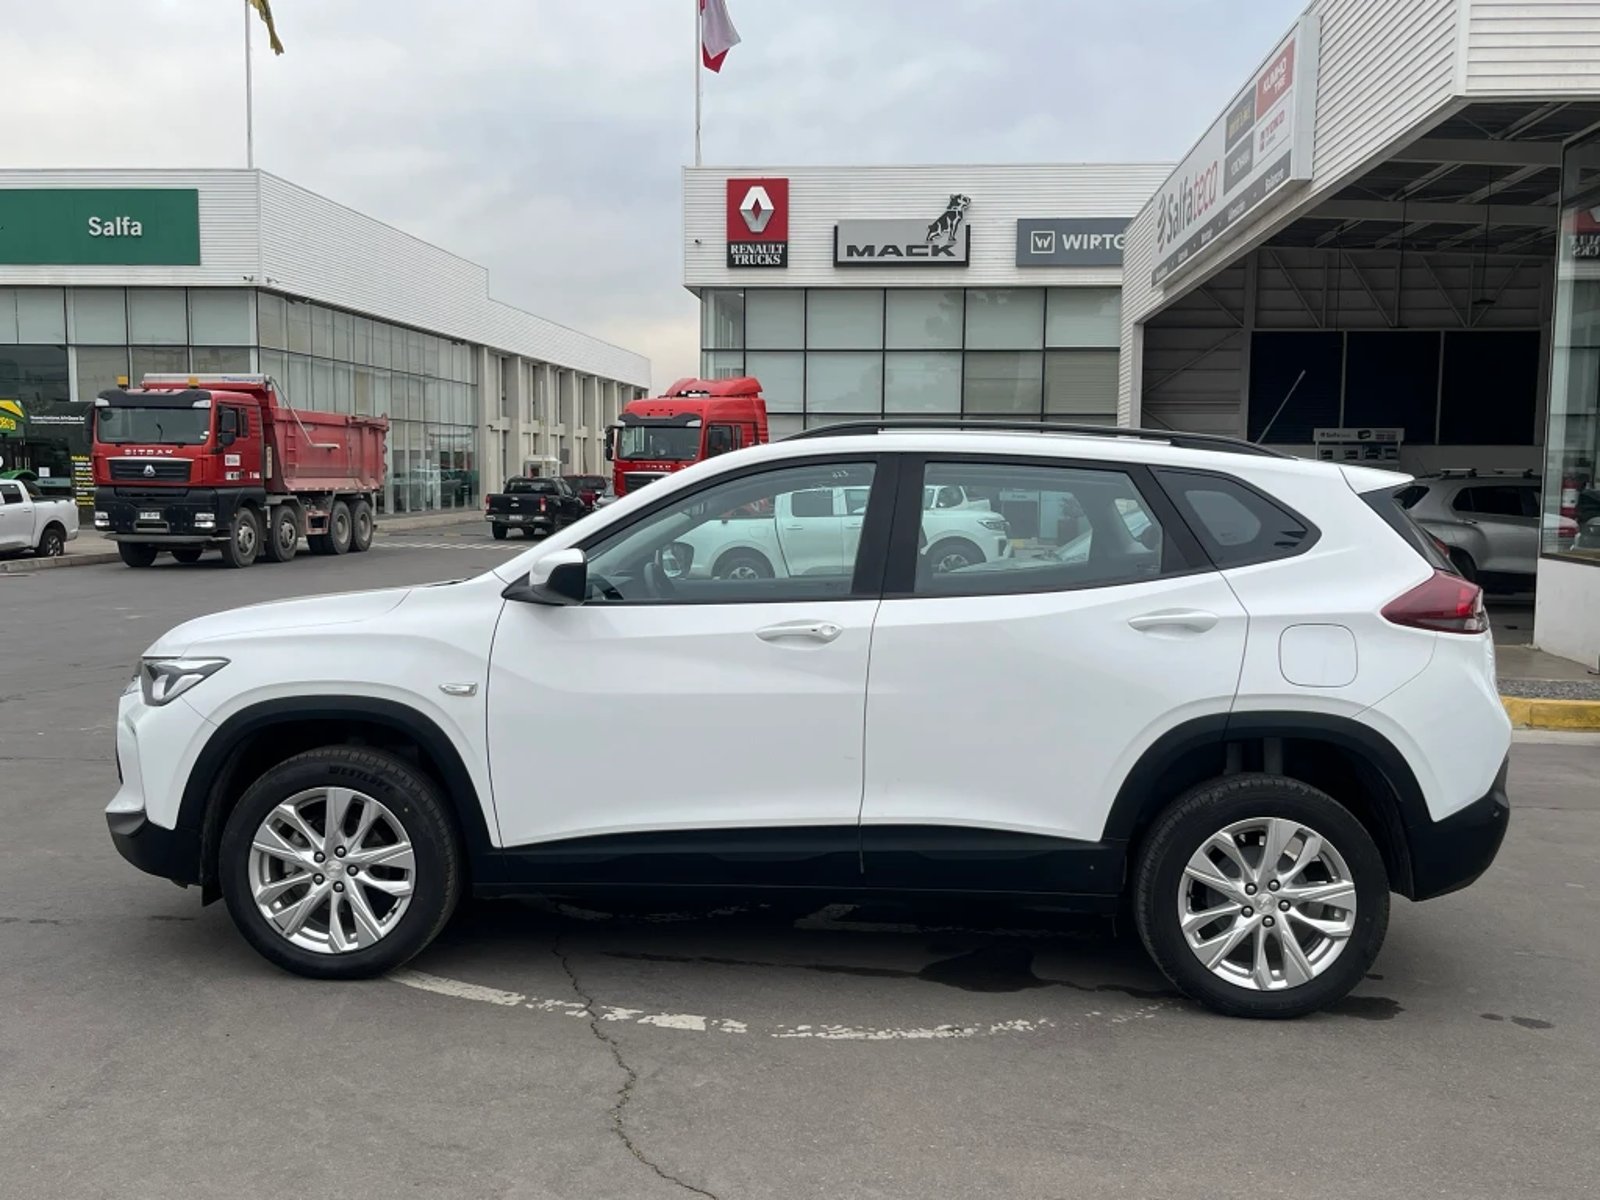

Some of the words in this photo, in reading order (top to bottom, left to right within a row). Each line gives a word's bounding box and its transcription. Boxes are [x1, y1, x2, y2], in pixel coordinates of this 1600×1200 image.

[1167, 160, 1218, 244] Salfateco
[88, 216, 142, 236] Salfa
[730, 243, 785, 254] RENAULT
[846, 244, 956, 257] MACK
[732, 254, 781, 265] TRUCKS
[124, 448, 174, 456] SITRAK
